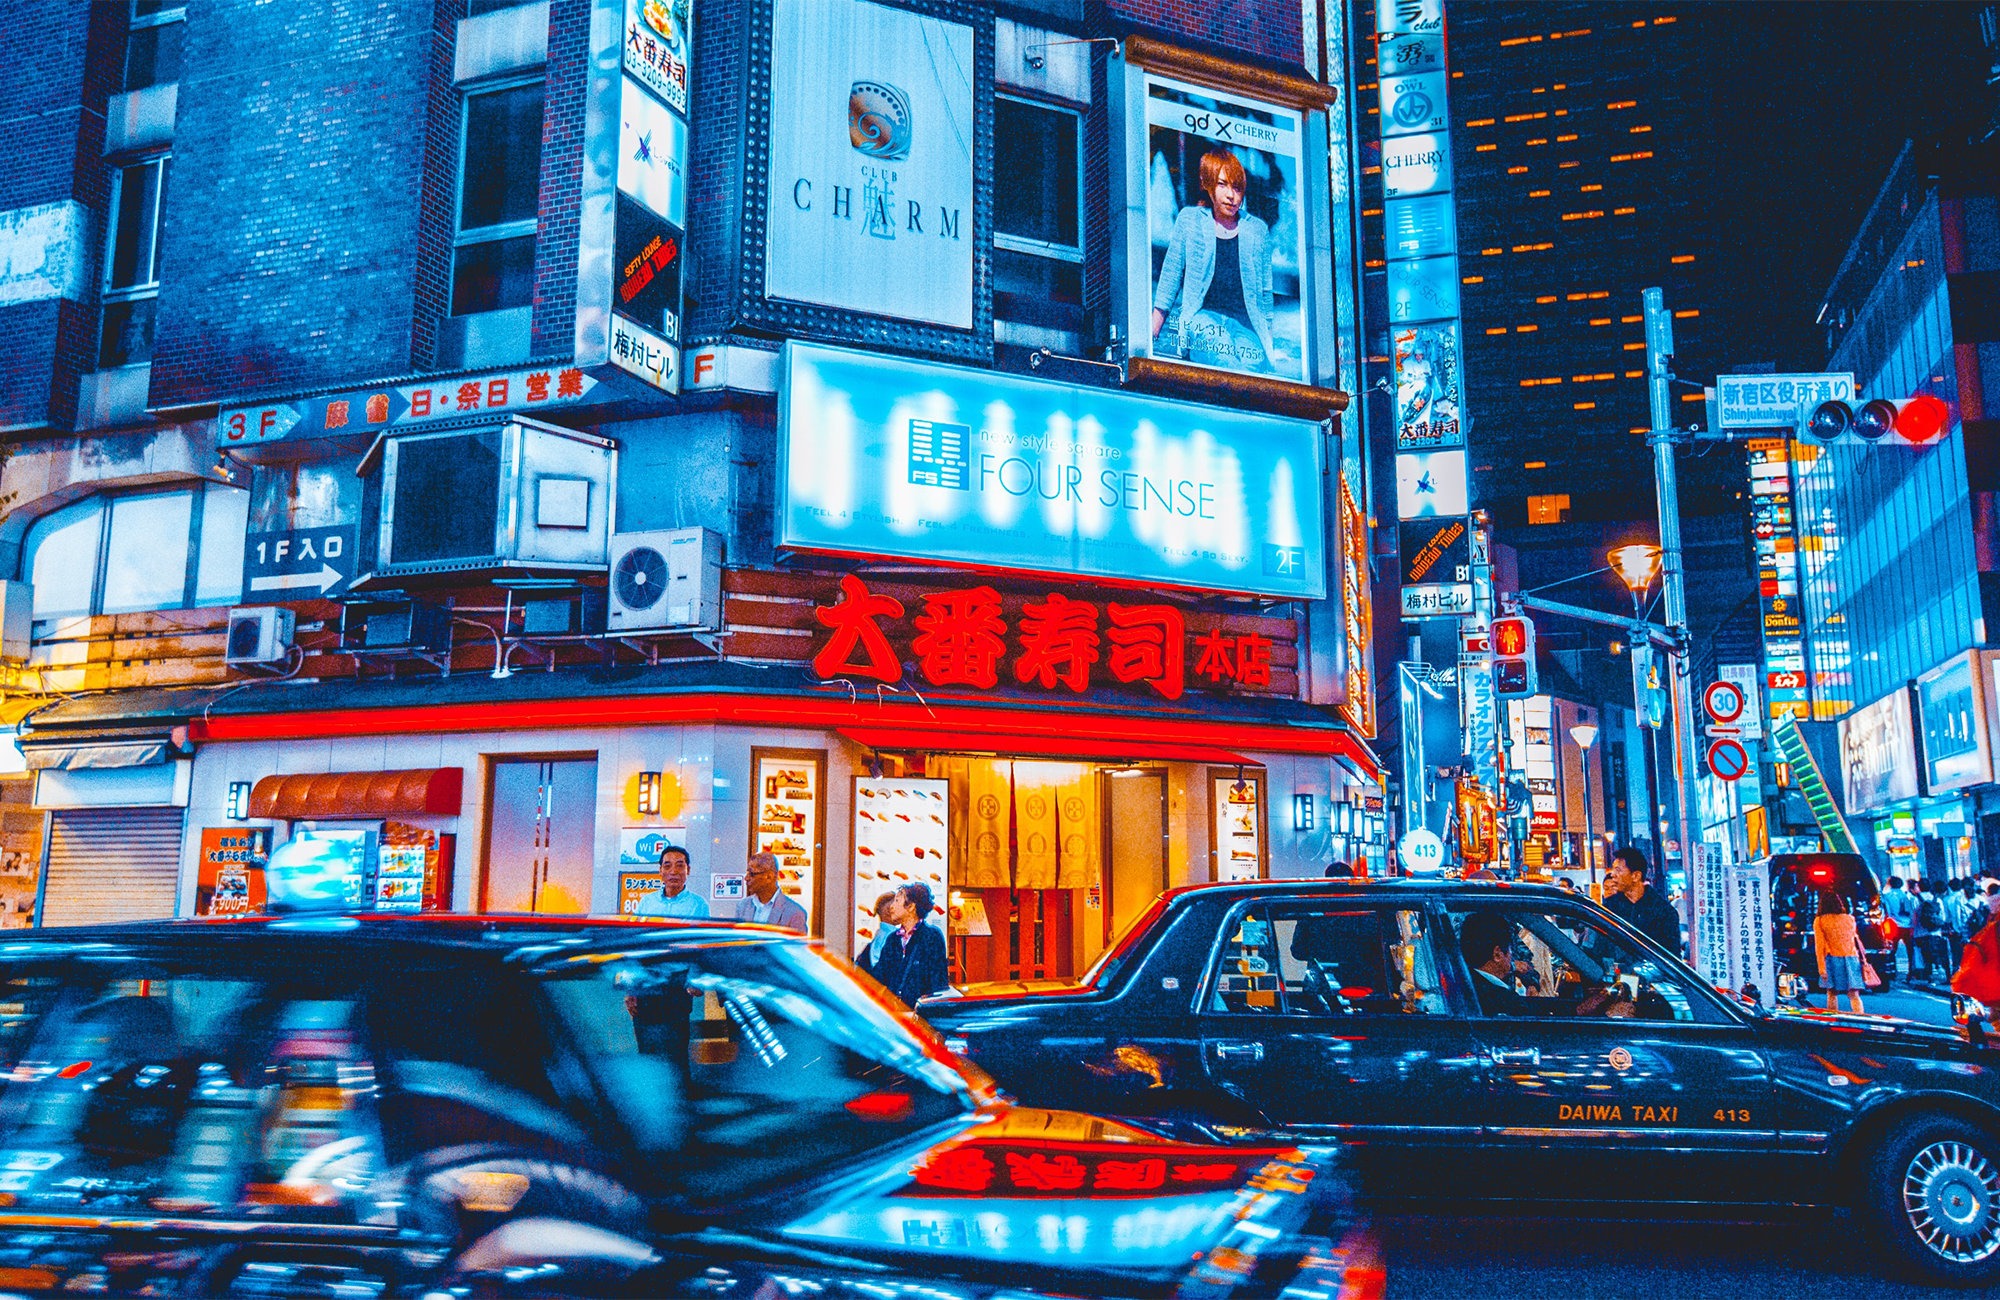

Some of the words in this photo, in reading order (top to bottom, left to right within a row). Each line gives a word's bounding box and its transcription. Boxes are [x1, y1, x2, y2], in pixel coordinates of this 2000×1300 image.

[1414, 17, 1441, 31] club
[627, 23, 686, 91] 大番寿司
[626, 48, 686, 108] 03-3209-9993
[1394, 82, 1427, 94] OWL
[1431, 116, 1446, 125] 3F
[1234, 123, 1278, 143] CHERRY
[1386, 150, 1446, 169] CHERRY
[861, 166, 897, 182] CLUB
[1387, 188, 1398, 196] 3F
[794, 178, 960, 239] CHARM
[1399, 240, 1419, 250] FS
[624, 255, 642, 278] SOFTY
[642, 235, 662, 261] LOUNGE
[1392, 265, 1420, 290] FOUR
[1419, 286, 1454, 313] SENSE
[1395, 301, 1411, 317] 2F
[664, 308, 679, 341] B1
[614, 329, 673, 380] 梅村ビル
[694, 354, 716, 384] F
[526, 368, 583, 402] 営業
[1723, 381, 1849, 405] 新宿区役所通り
[1724, 407, 1797, 422] Shinjukukuya
[1400, 419, 1459, 438] 大番寿司
[980, 430, 1015, 445] new
[1022, 432, 1058, 454] style
[1067, 441, 1122, 460] square
[912, 470, 939, 484] FS
[980, 453, 1083, 503] FOUR
[1099, 469, 1215, 519] SENSE
[838, 510, 847, 518] 4
[949, 521, 958, 530] 4
[257, 536, 342, 564] 1F入口
[1191, 549, 1198, 558] 4
[1412, 547, 1428, 565] SOFTY
[1276, 550, 1301, 574] 2F
[1455, 564, 1470, 581] B1
[1407, 592, 1468, 608] 梅村ビル
[813, 573, 1184, 700] 大番寿司
[1195, 629, 1272, 686] 本店
[1714, 693, 1735, 711] 30
[1414, 845, 1436, 858] 413
[1559, 1104, 1622, 1121] DAIWA
[1632, 1105, 1678, 1122] TAXI
[1713, 1109, 1751, 1123] 413
